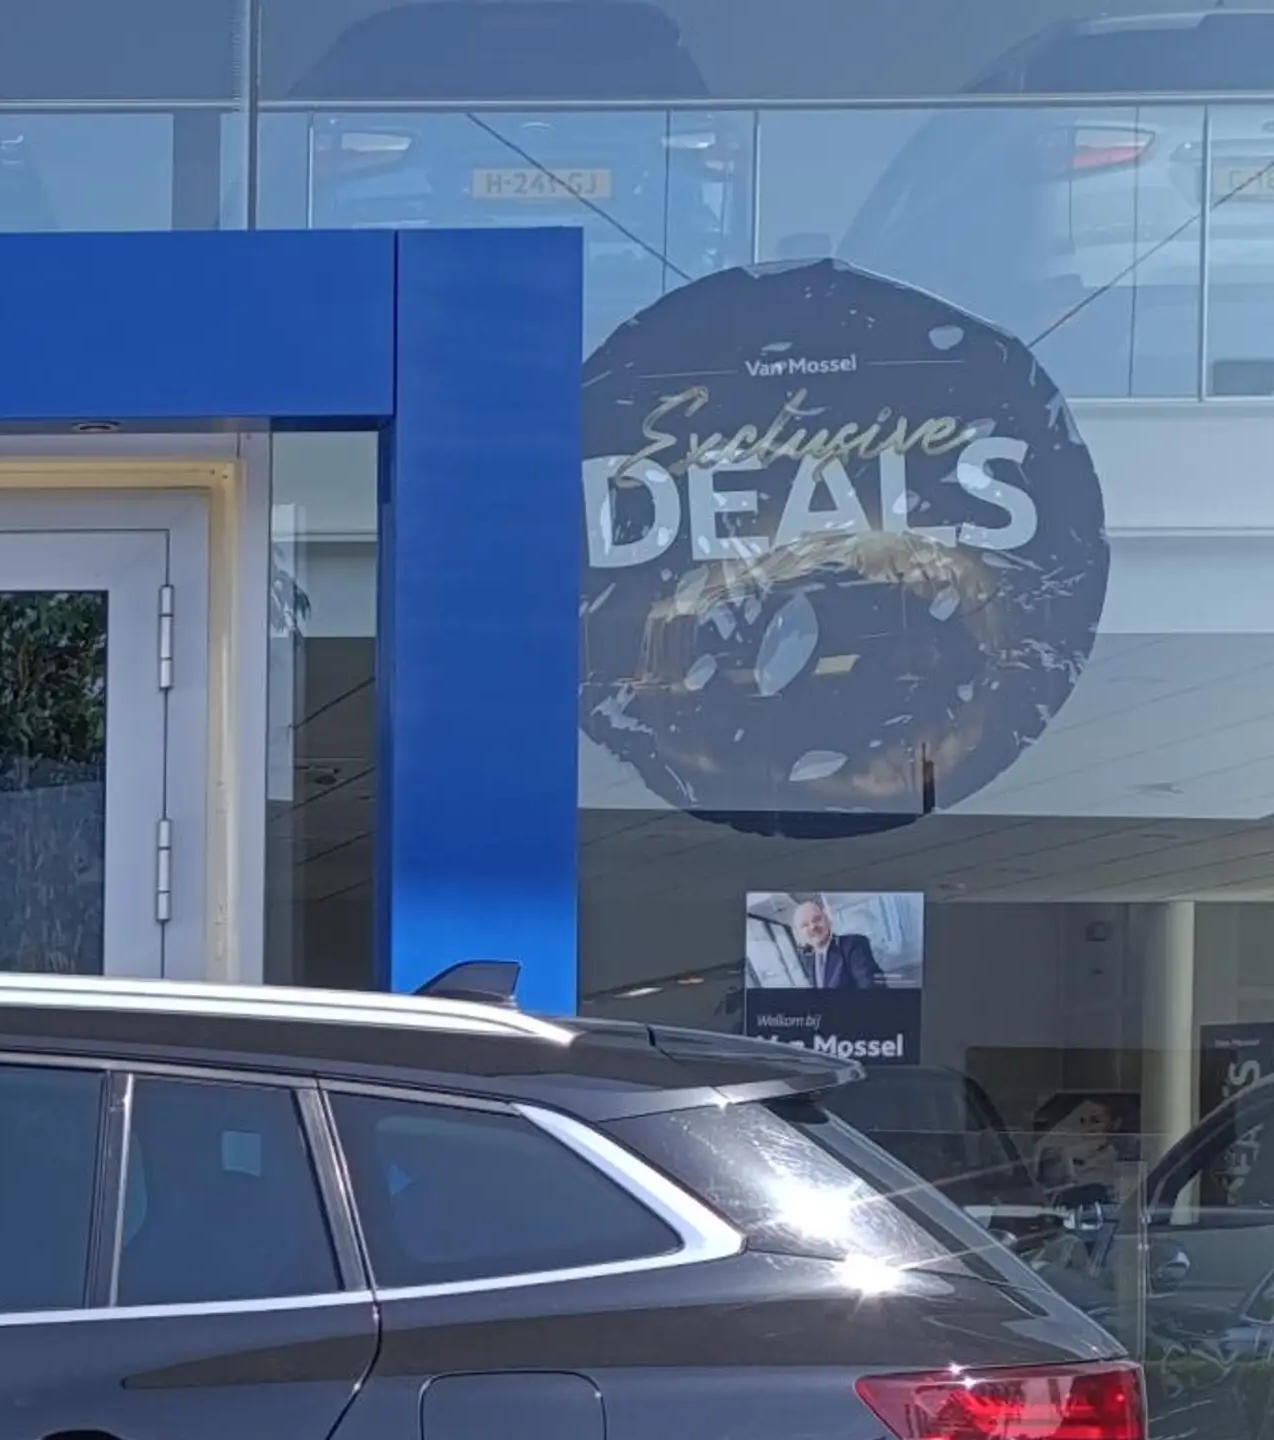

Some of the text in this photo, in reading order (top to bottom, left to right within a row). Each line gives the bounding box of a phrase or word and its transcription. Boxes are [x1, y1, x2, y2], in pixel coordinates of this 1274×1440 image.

[745, 353, 857, 377] Van Mossel
[613, 386, 995, 482] Exclusive
[581, 436, 1038, 568] DEALS
[813, 1033, 904, 1058] Mossel
